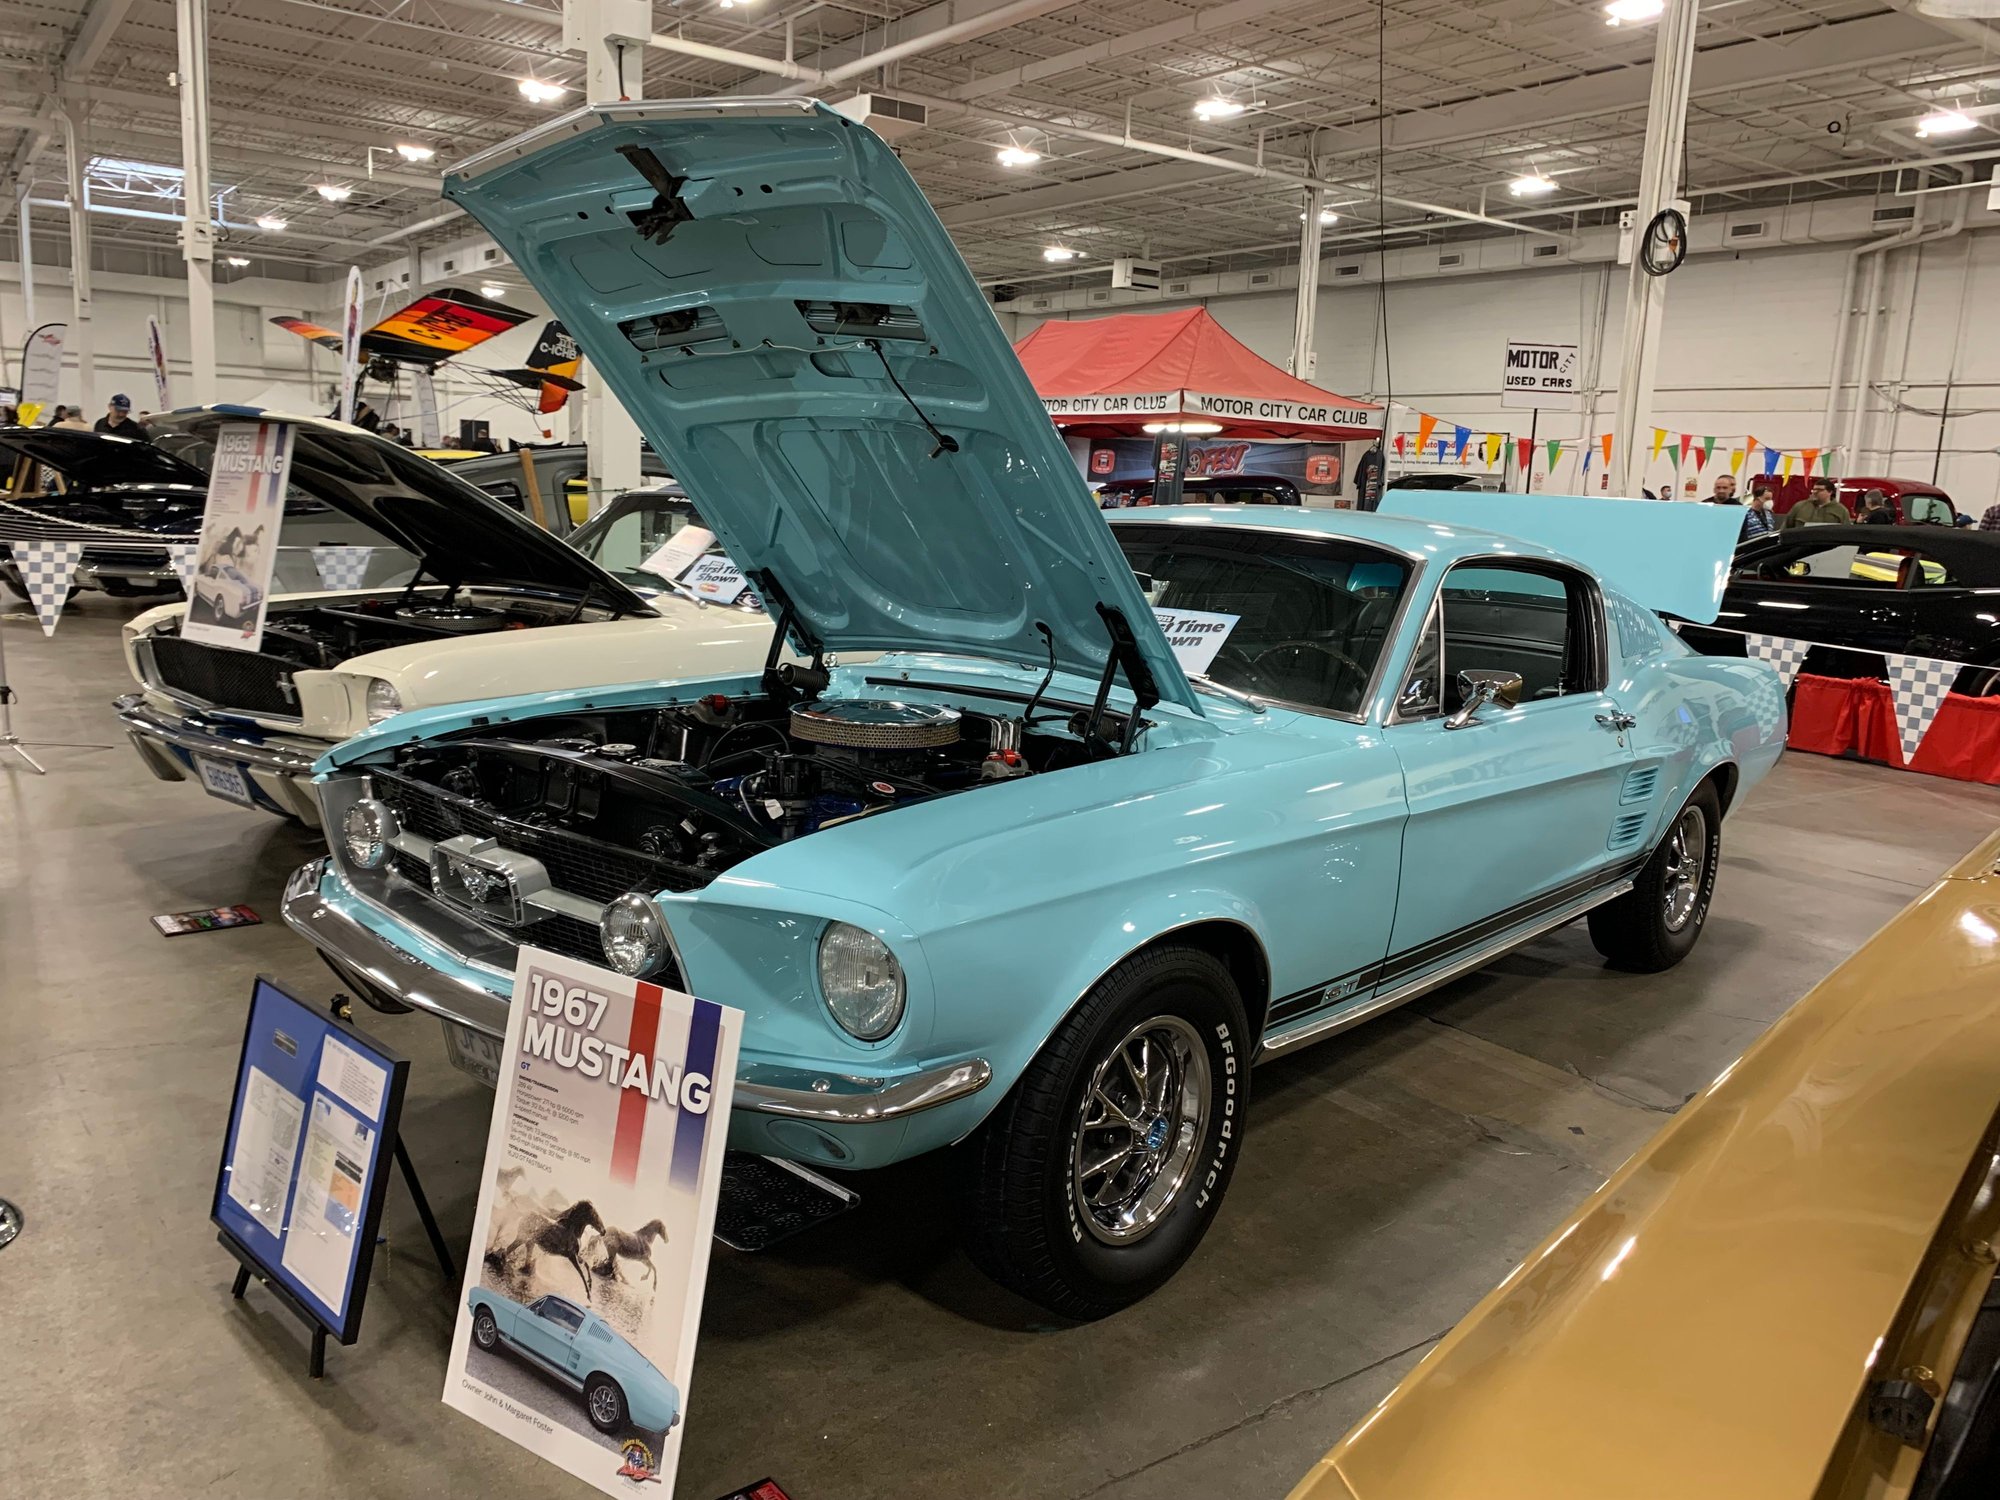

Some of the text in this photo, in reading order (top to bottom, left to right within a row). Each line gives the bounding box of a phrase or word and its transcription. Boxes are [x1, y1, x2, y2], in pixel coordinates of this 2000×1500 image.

[540, 342, 577, 360] C-ICHB
[1507, 349, 1560, 370] MOTOR
[1559, 352, 1576, 374] CITY
[1506, 376, 1573, 388] USED CARS
[1042, 395, 1167, 412] TOR CITY CAR CLUB
[1201, 396, 1368, 425] MOTOR CITY CAR CLUB
[222, 434, 251, 453] 1965
[1392, 440, 1416, 448] Ldon
[217, 454, 284, 474] MUSTANG
[696, 564, 724, 574] First
[696, 573, 738, 583] Shown
[1175, 619, 1226, 633] Time
[1705, 834, 1719, 896] Radial
[532, 974, 608, 1031] 1967
[520, 1061, 531, 1071] GT
[522, 1016, 712, 1115] MUSTANG
[1195, 1022, 1237, 1209] BFGoodrich
[504, 1402, 533, 1424] Margaret
[532, 1417, 554, 1434] Foster
